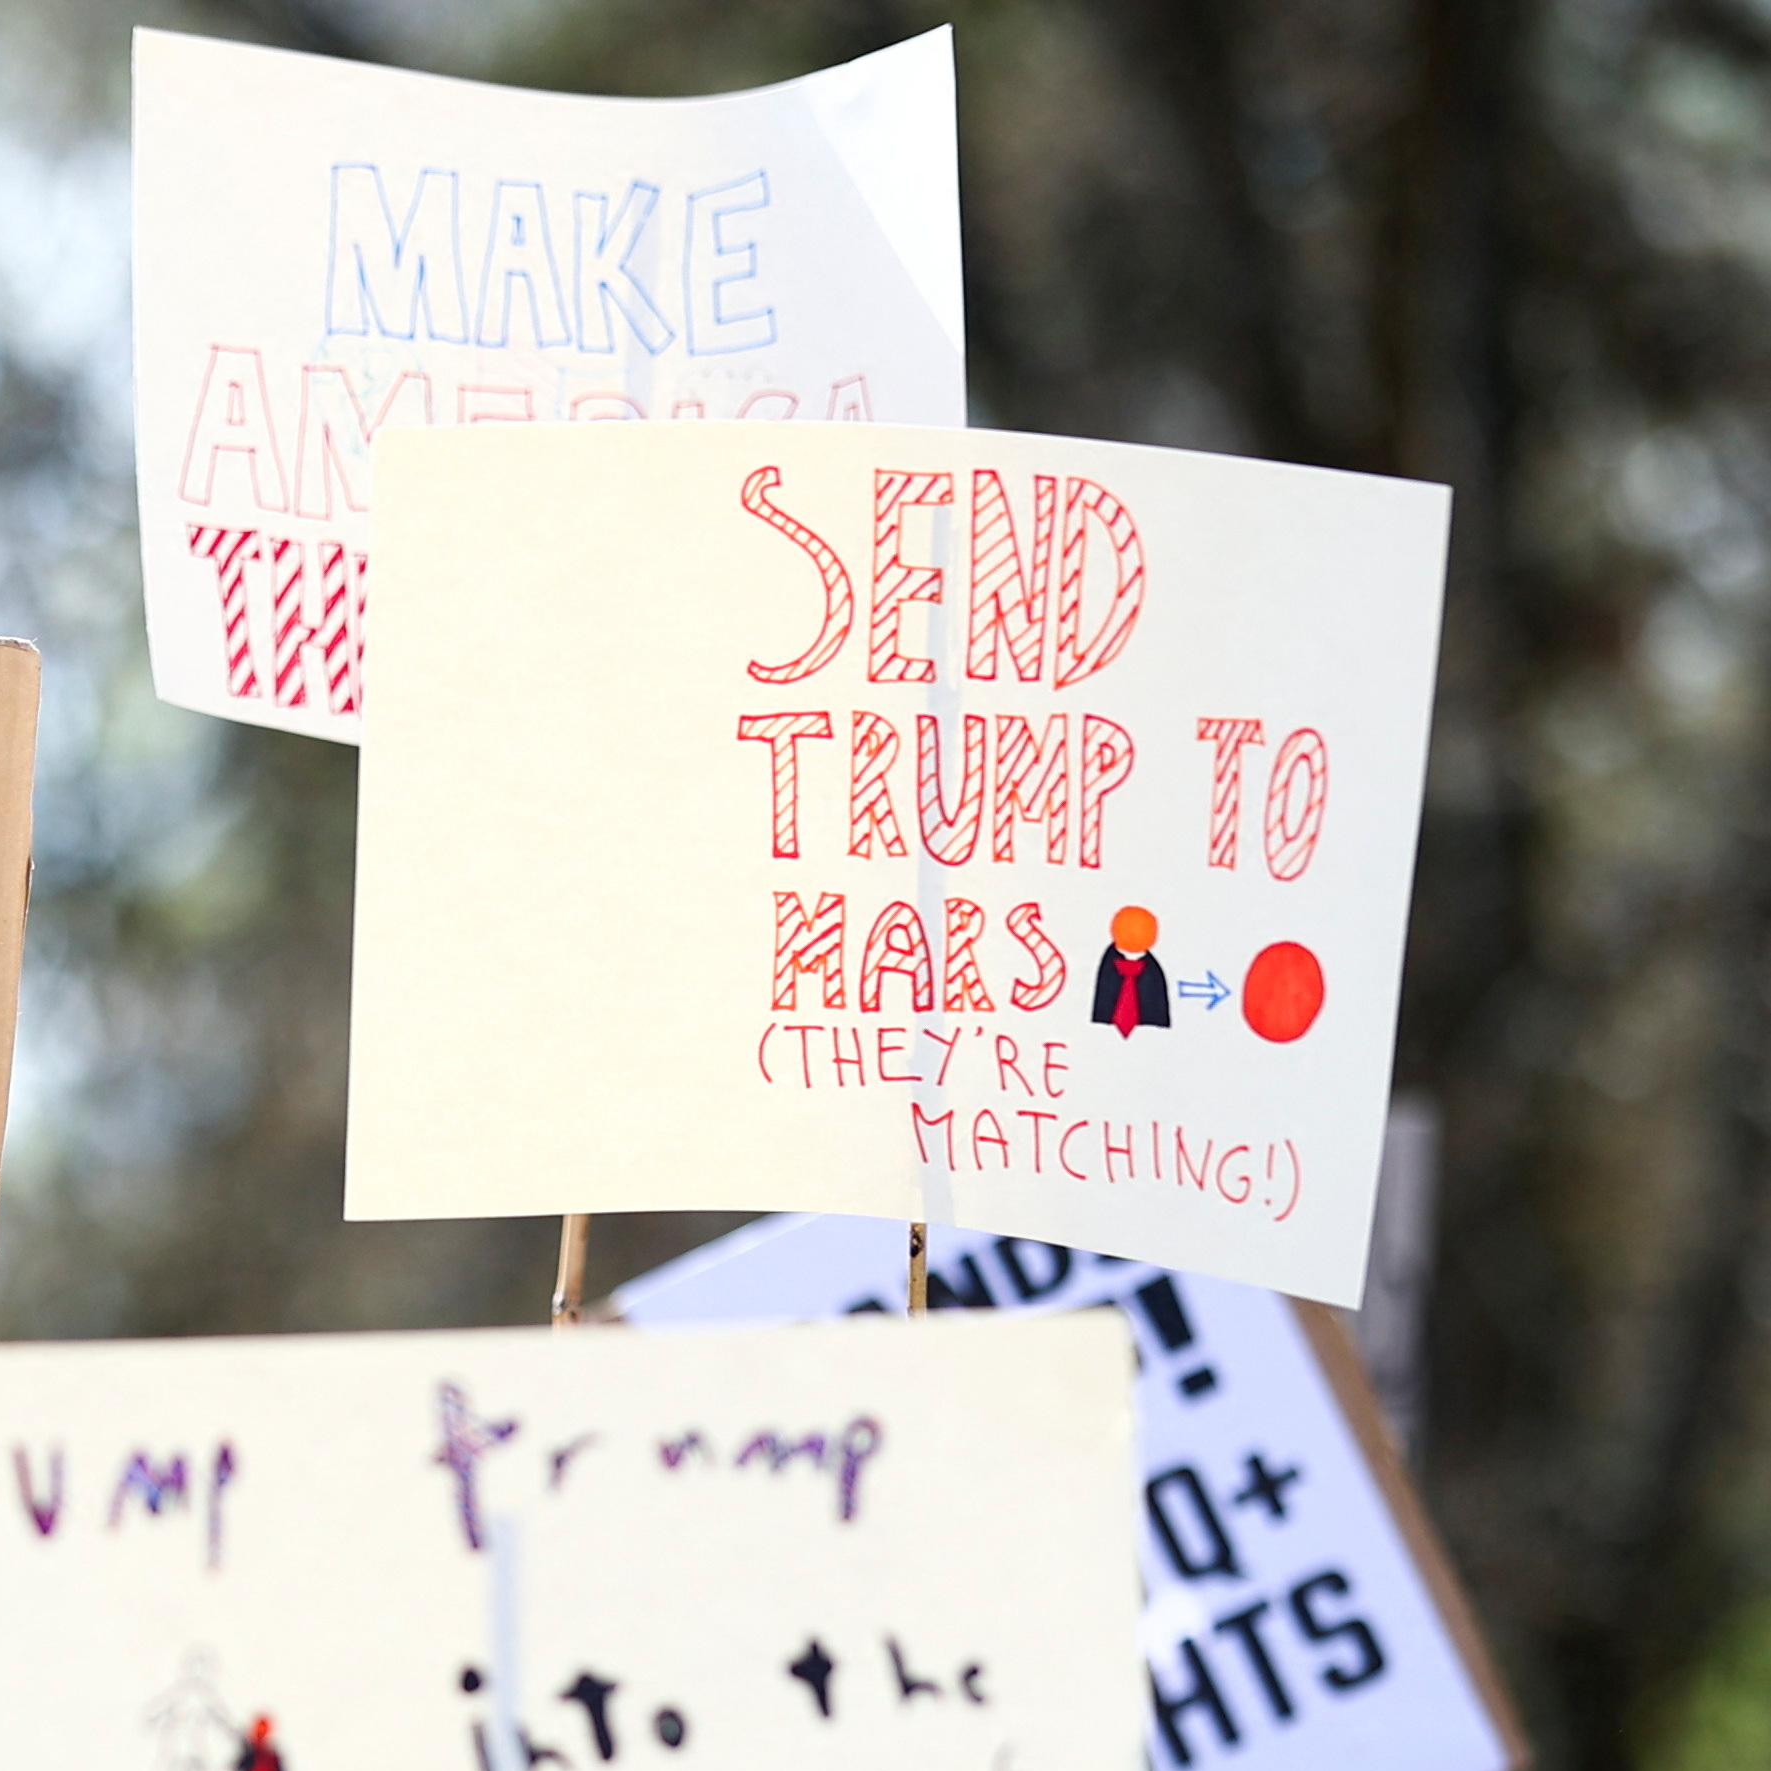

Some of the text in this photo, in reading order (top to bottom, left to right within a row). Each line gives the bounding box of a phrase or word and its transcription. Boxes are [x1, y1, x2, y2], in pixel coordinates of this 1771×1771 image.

[324, 162, 778, 357] MAKE
[738, 465, 1147, 692] SEND
[736, 709, 1331, 882] TRUMP TO
[769, 890, 1069, 1014] MARS
[757, 1021, 1072, 1098] (THEY'RE
[910, 1102, 1302, 1222] MATCHING!)
